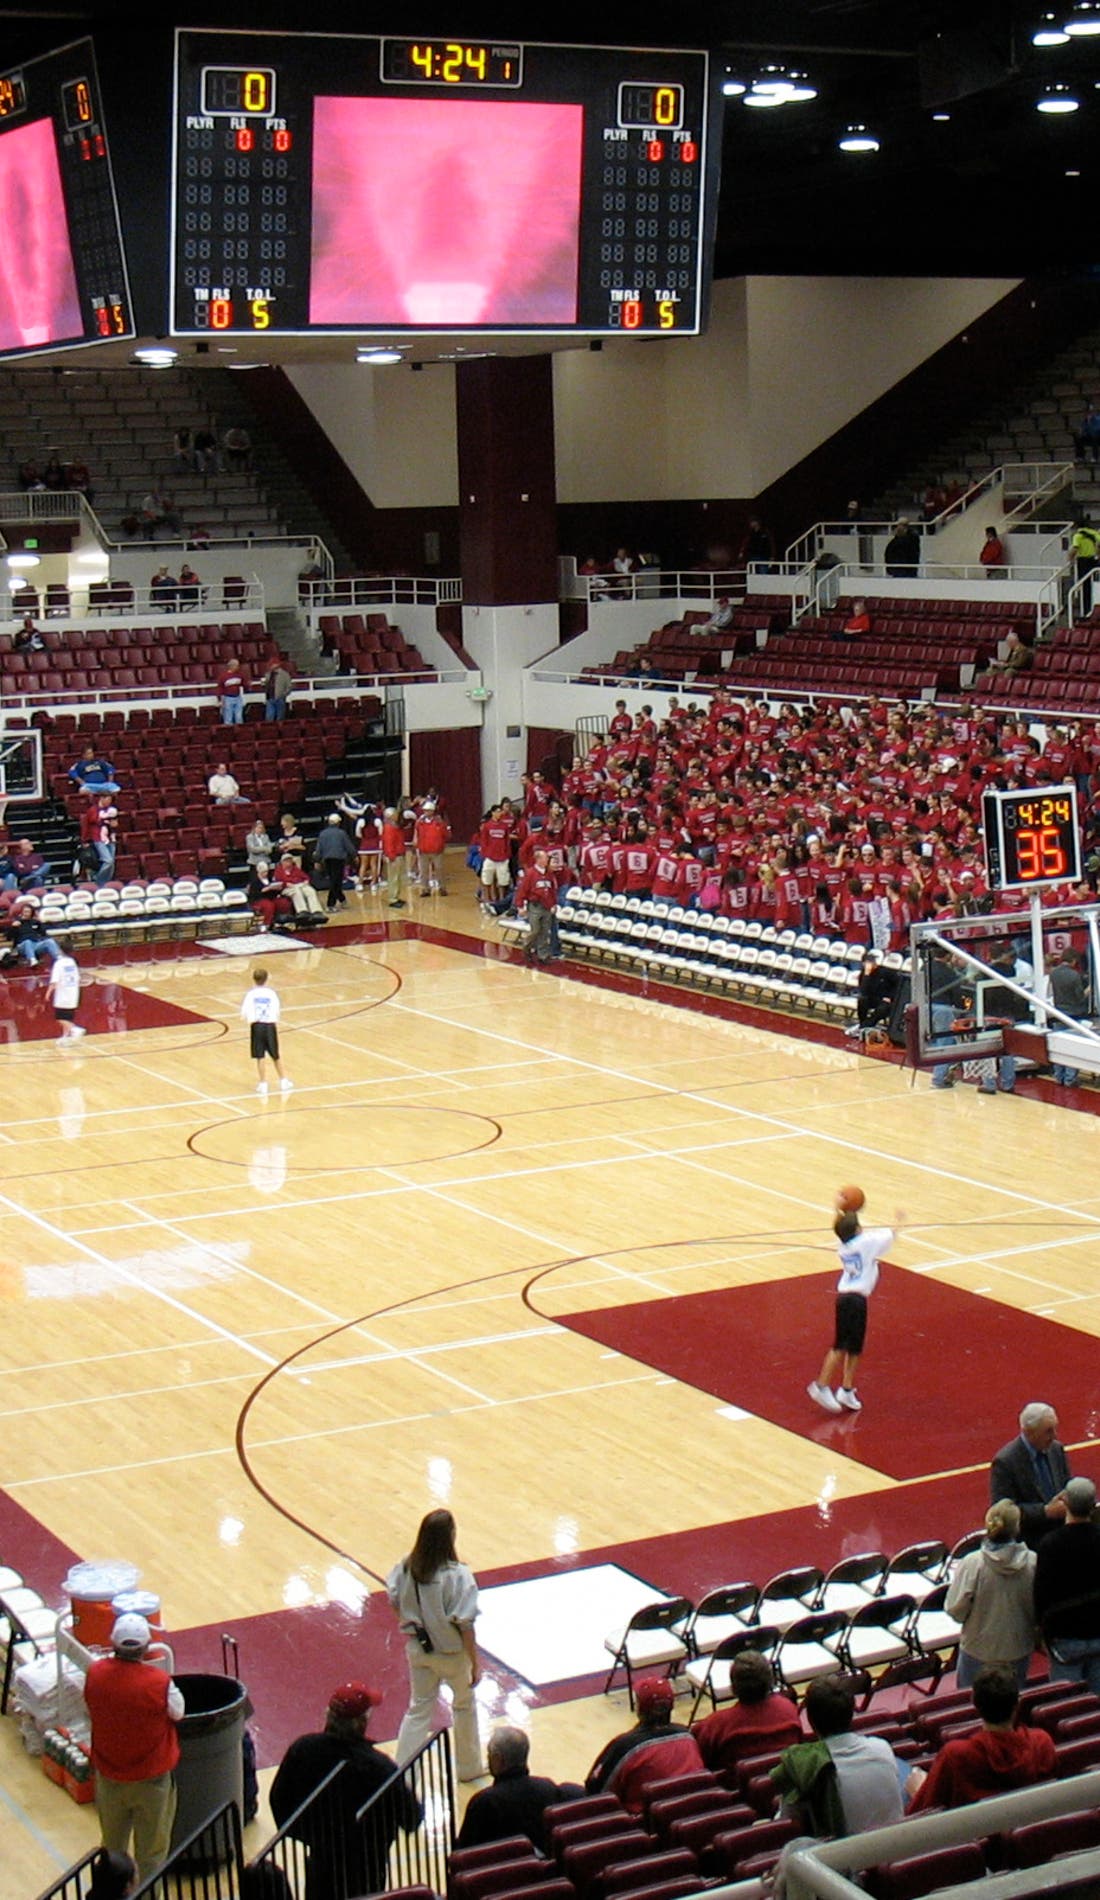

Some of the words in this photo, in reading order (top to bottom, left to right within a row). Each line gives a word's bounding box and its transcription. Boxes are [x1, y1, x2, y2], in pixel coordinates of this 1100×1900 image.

[412, 44, 486, 82] 4:24
[504, 61, 511, 80] 1
[245, 72, 266, 111] 0
[656, 88, 675, 124] 0
[186, 116, 215, 130] PLYR
[230, 117, 247, 130] FLS
[265, 118, 287, 131] PTS
[603, 128, 628, 141] PLYR
[673, 131, 691, 143] PTS
[238, 129, 251, 151] 0
[276, 130, 289, 151] 0
[650, 141, 661, 161] 0
[682, 142, 695, 162] 0
[194, 288, 209, 301] TM
[212, 288, 231, 301] FLS
[624, 290, 640, 302] FLS
[212, 300, 230, 328] 0
[252, 300, 270, 329] 5
[625, 301, 640, 328] 0
[660, 301, 674, 328] 5
[1018, 799, 1070, 826] 4:24
[1017, 829, 1063, 878] 35
